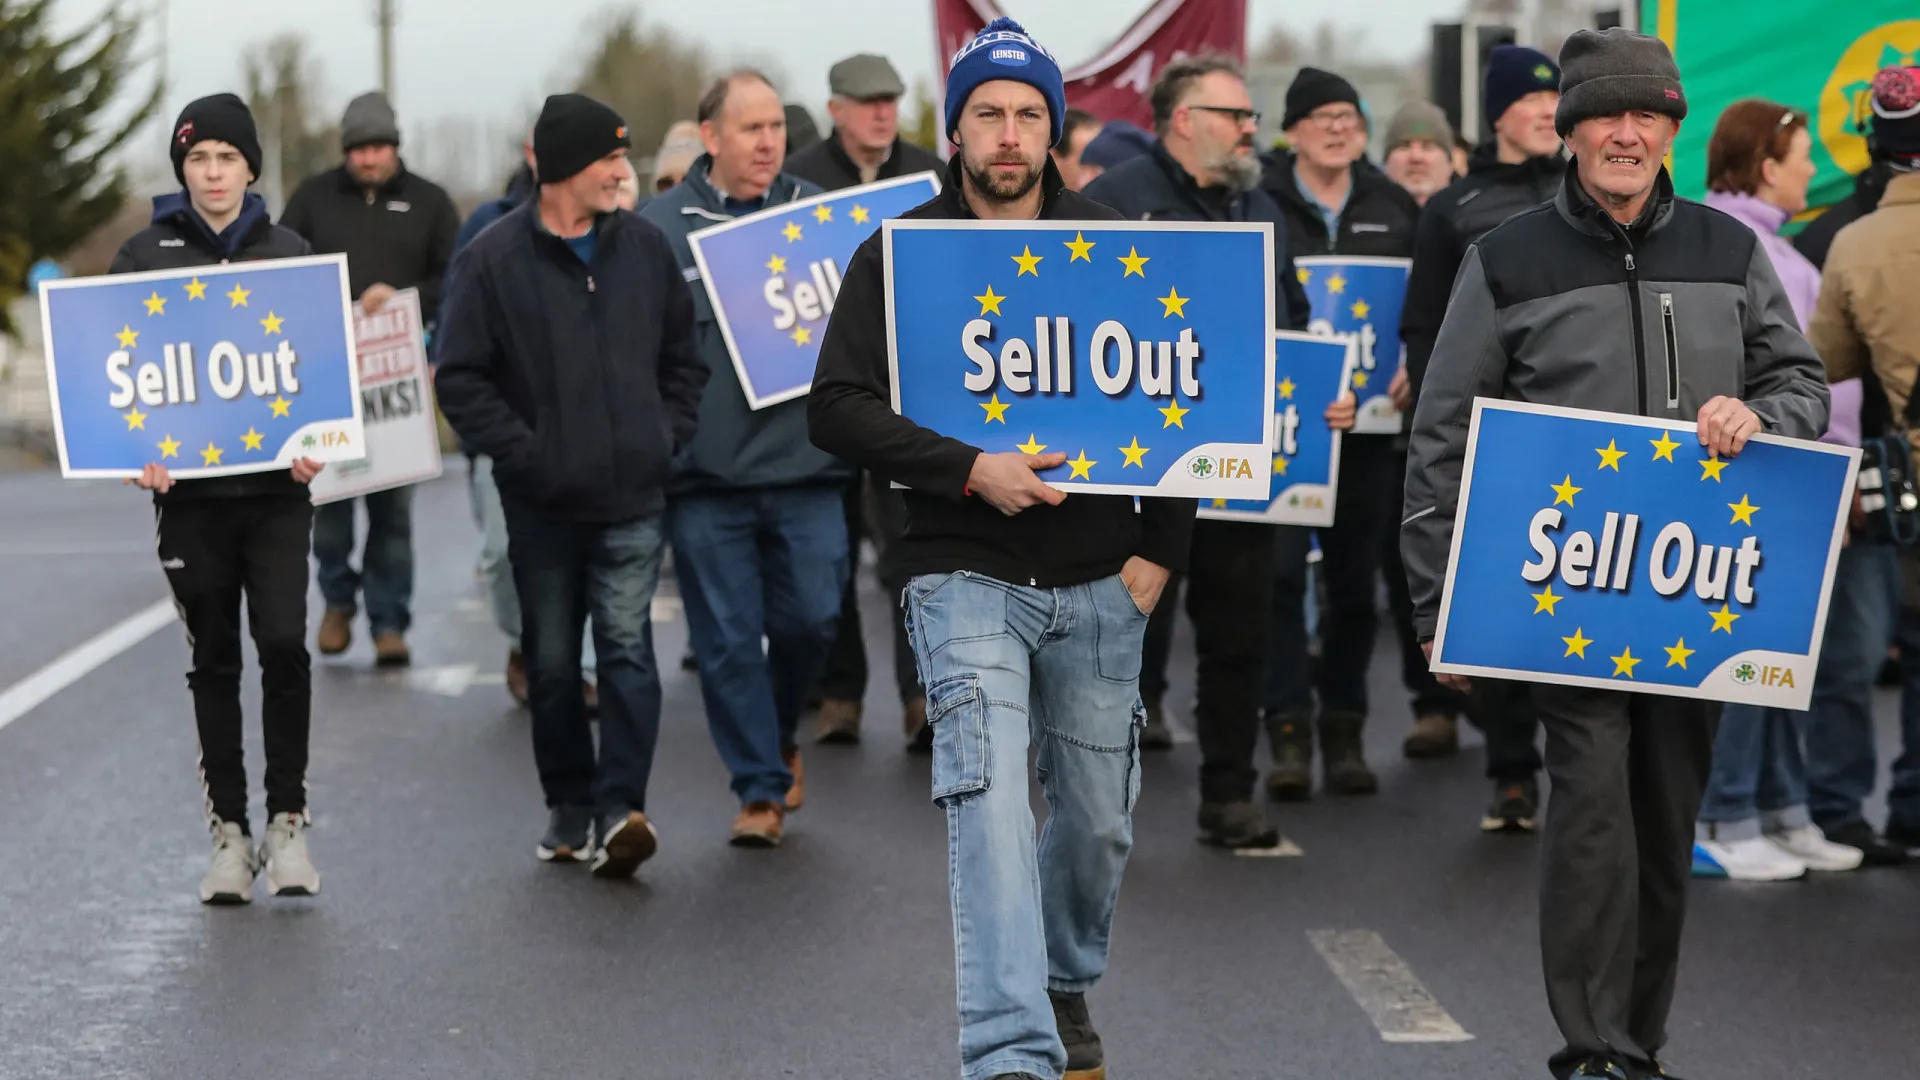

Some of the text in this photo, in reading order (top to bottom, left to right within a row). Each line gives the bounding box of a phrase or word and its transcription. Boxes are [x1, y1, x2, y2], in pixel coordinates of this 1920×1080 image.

[992, 49, 1025, 61] LEINSTER
[764, 258, 842, 330] Sell
[106, 339, 299, 408] Sell Out
[962, 317, 1199, 397] Sell Out
[322, 430, 350, 448] IFA
[1219, 458, 1253, 479] IFA
[1521, 508, 1760, 604] Sell Out
[1761, 665, 1794, 688] IFA
